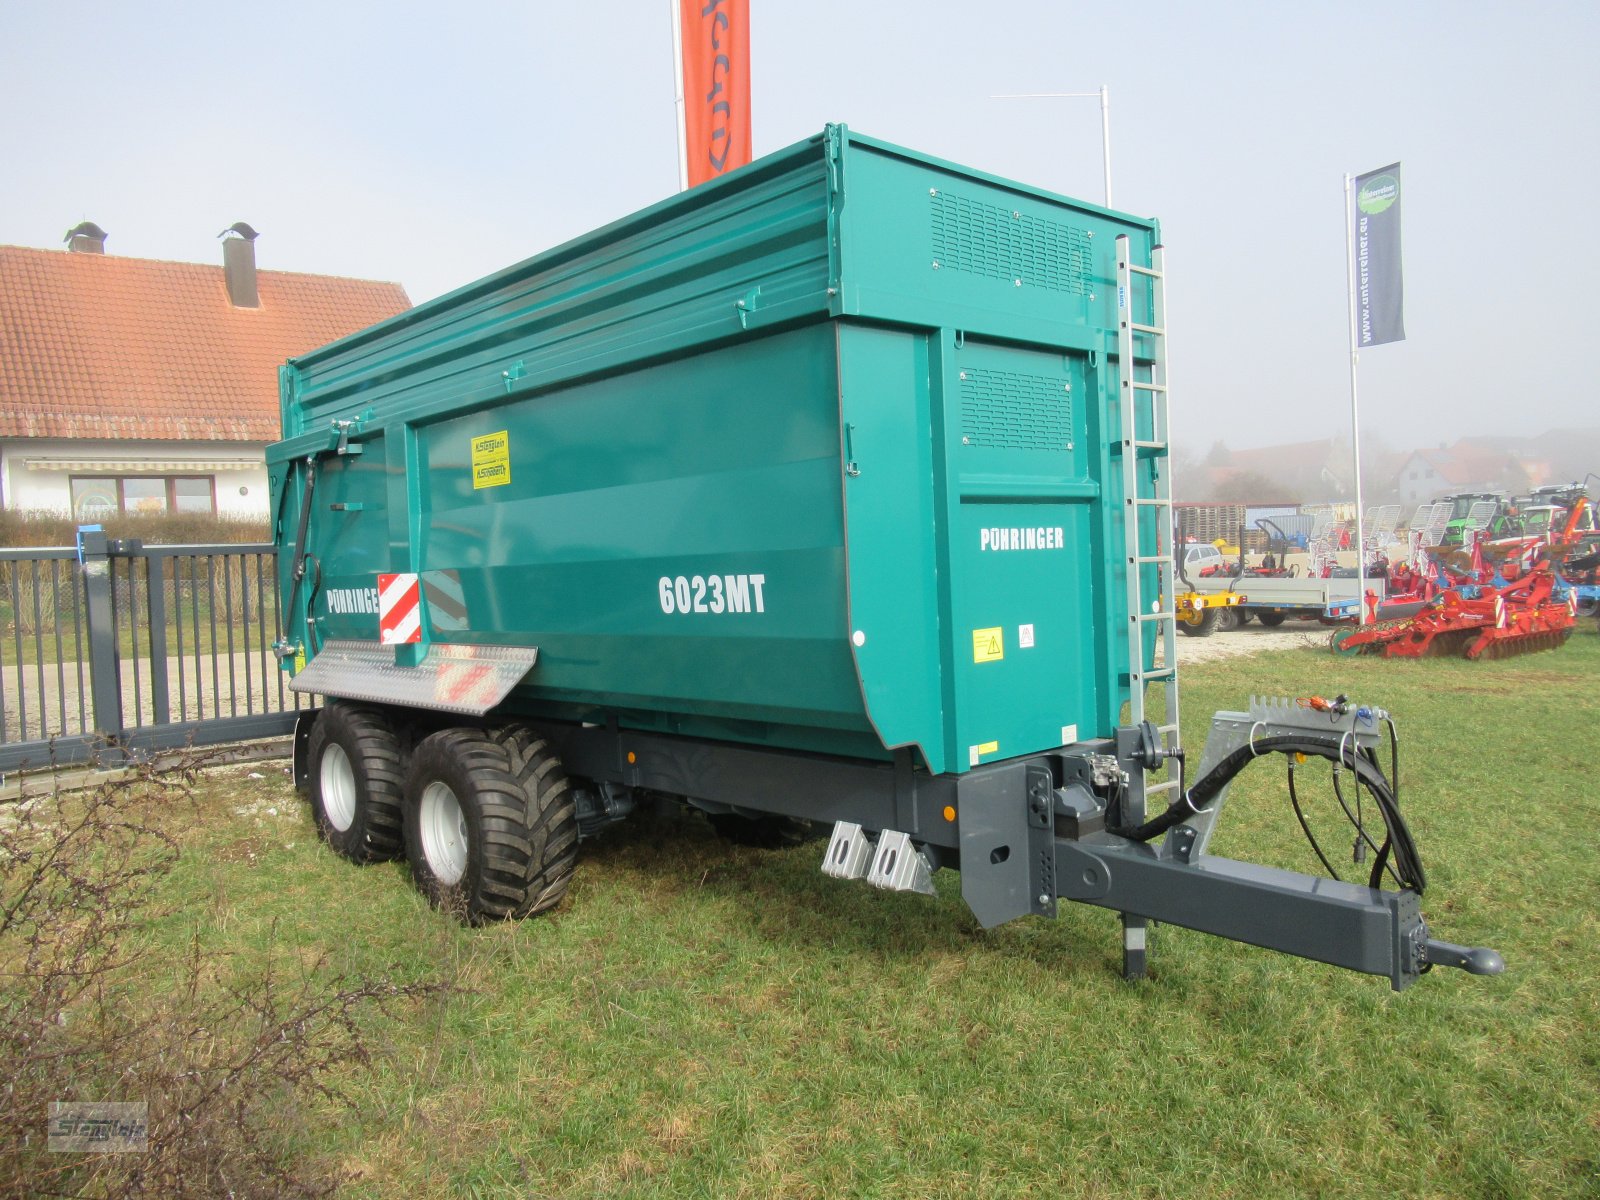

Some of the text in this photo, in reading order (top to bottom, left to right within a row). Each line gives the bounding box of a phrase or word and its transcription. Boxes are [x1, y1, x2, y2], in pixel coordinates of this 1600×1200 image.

[1358, 216, 1371, 344] www.unterreiner.eu
[980, 527, 1064, 551] PÜHRINGER
[326, 588, 379, 614] PÜHRINGE
[658, 574, 765, 614] 6023MT
